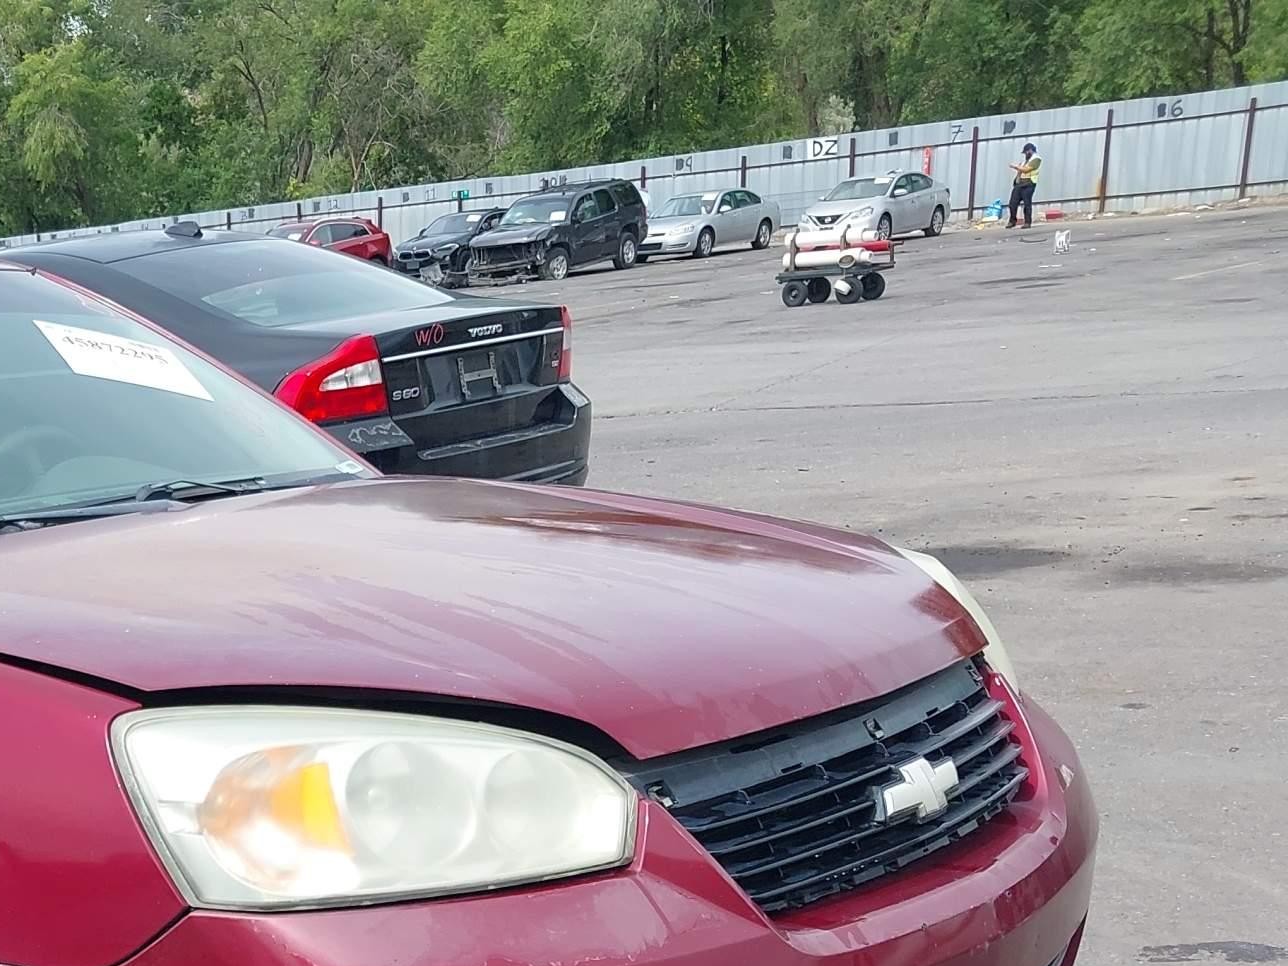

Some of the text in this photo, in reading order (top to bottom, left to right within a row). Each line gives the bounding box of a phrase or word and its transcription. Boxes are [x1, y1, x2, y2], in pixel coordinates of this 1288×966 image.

[1170, 99, 1184, 117] 6
[951, 125, 964, 143] 7
[414, 321, 444, 347] W/O
[468, 323, 503, 338] VOLVO
